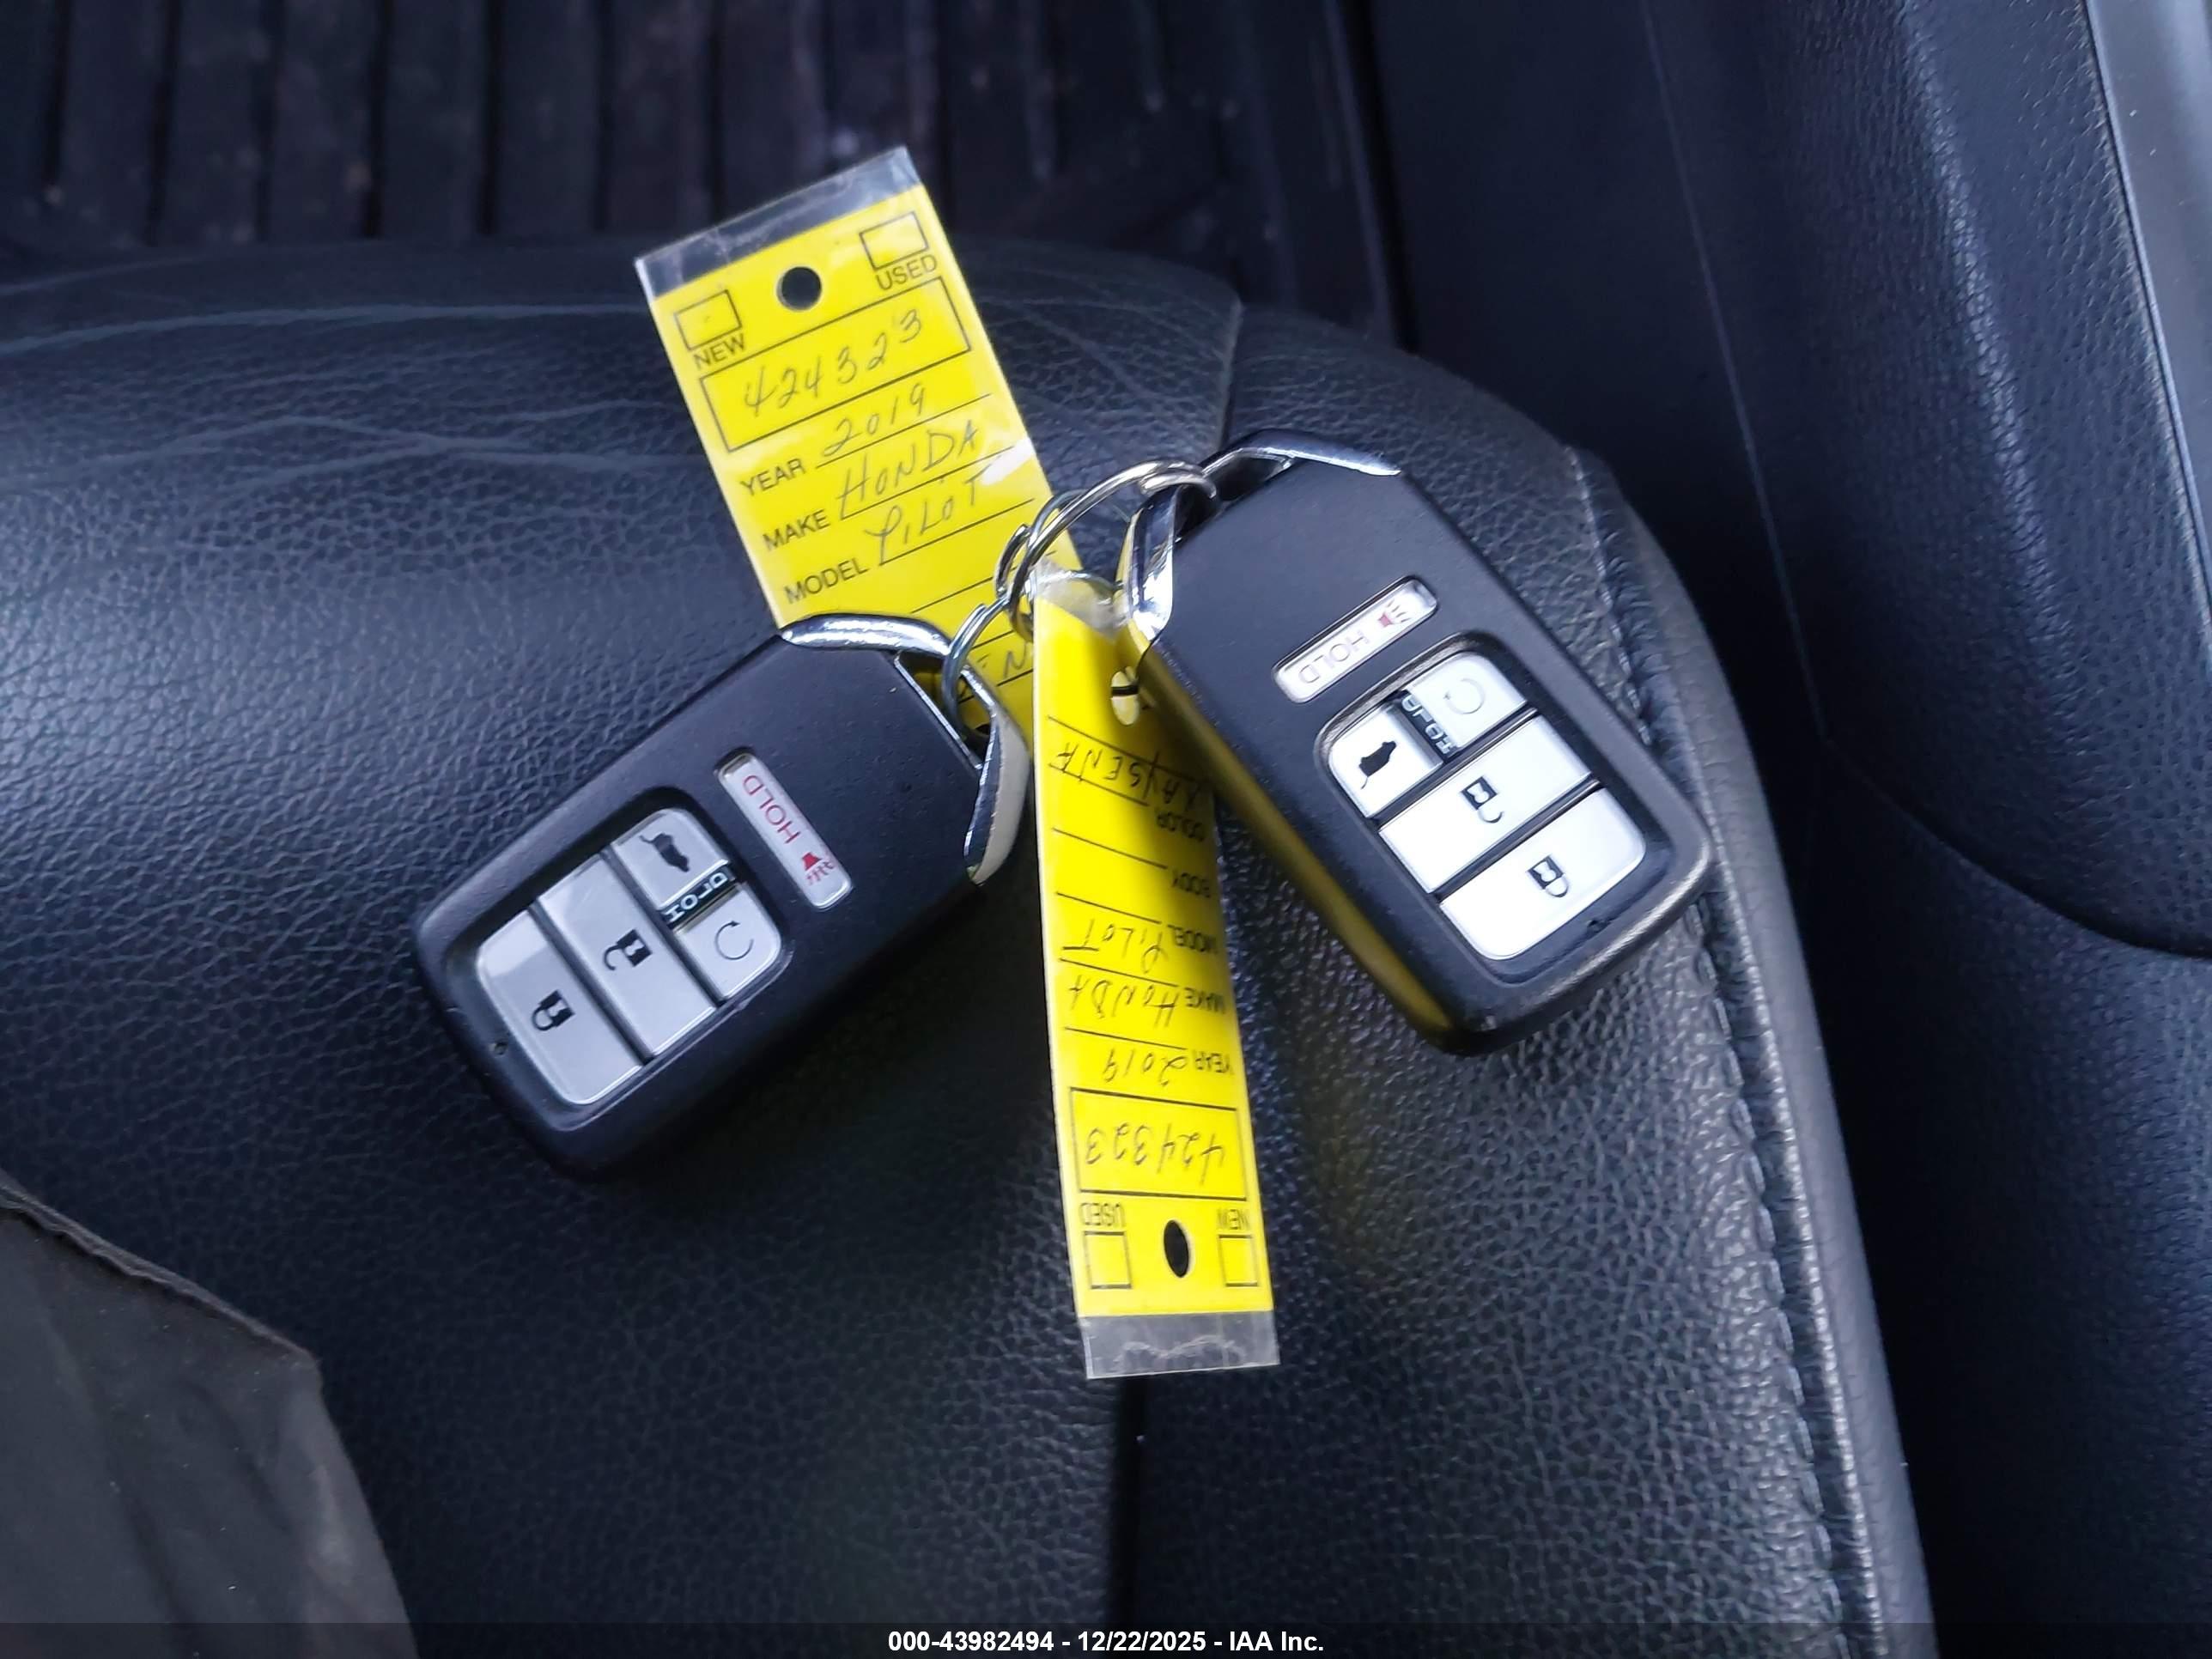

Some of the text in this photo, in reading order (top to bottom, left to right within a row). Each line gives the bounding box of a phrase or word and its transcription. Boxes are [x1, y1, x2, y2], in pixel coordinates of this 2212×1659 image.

[877, 253, 938, 292] USED
[693, 332, 747, 370] NEW
[744, 307, 922, 419] 424323
[740, 382, 927, 497] YEAR 2019
[762, 418, 978, 552] MAKE HONDA
[783, 559, 869, 605] MODEL
[1297, 630, 1371, 684] HOLD
[742, 774, 801, 844] HOLD
[663, 871, 729, 923] HOLD
[1068, 973, 1228, 1029] MAKE HONDA
[1103, 1048, 1235, 1086] YEAR 2019
[1086, 1122, 1226, 1186] 424323
[1080, 1202, 1126, 1227] USED
[1218, 1207, 1249, 1231] NEW
